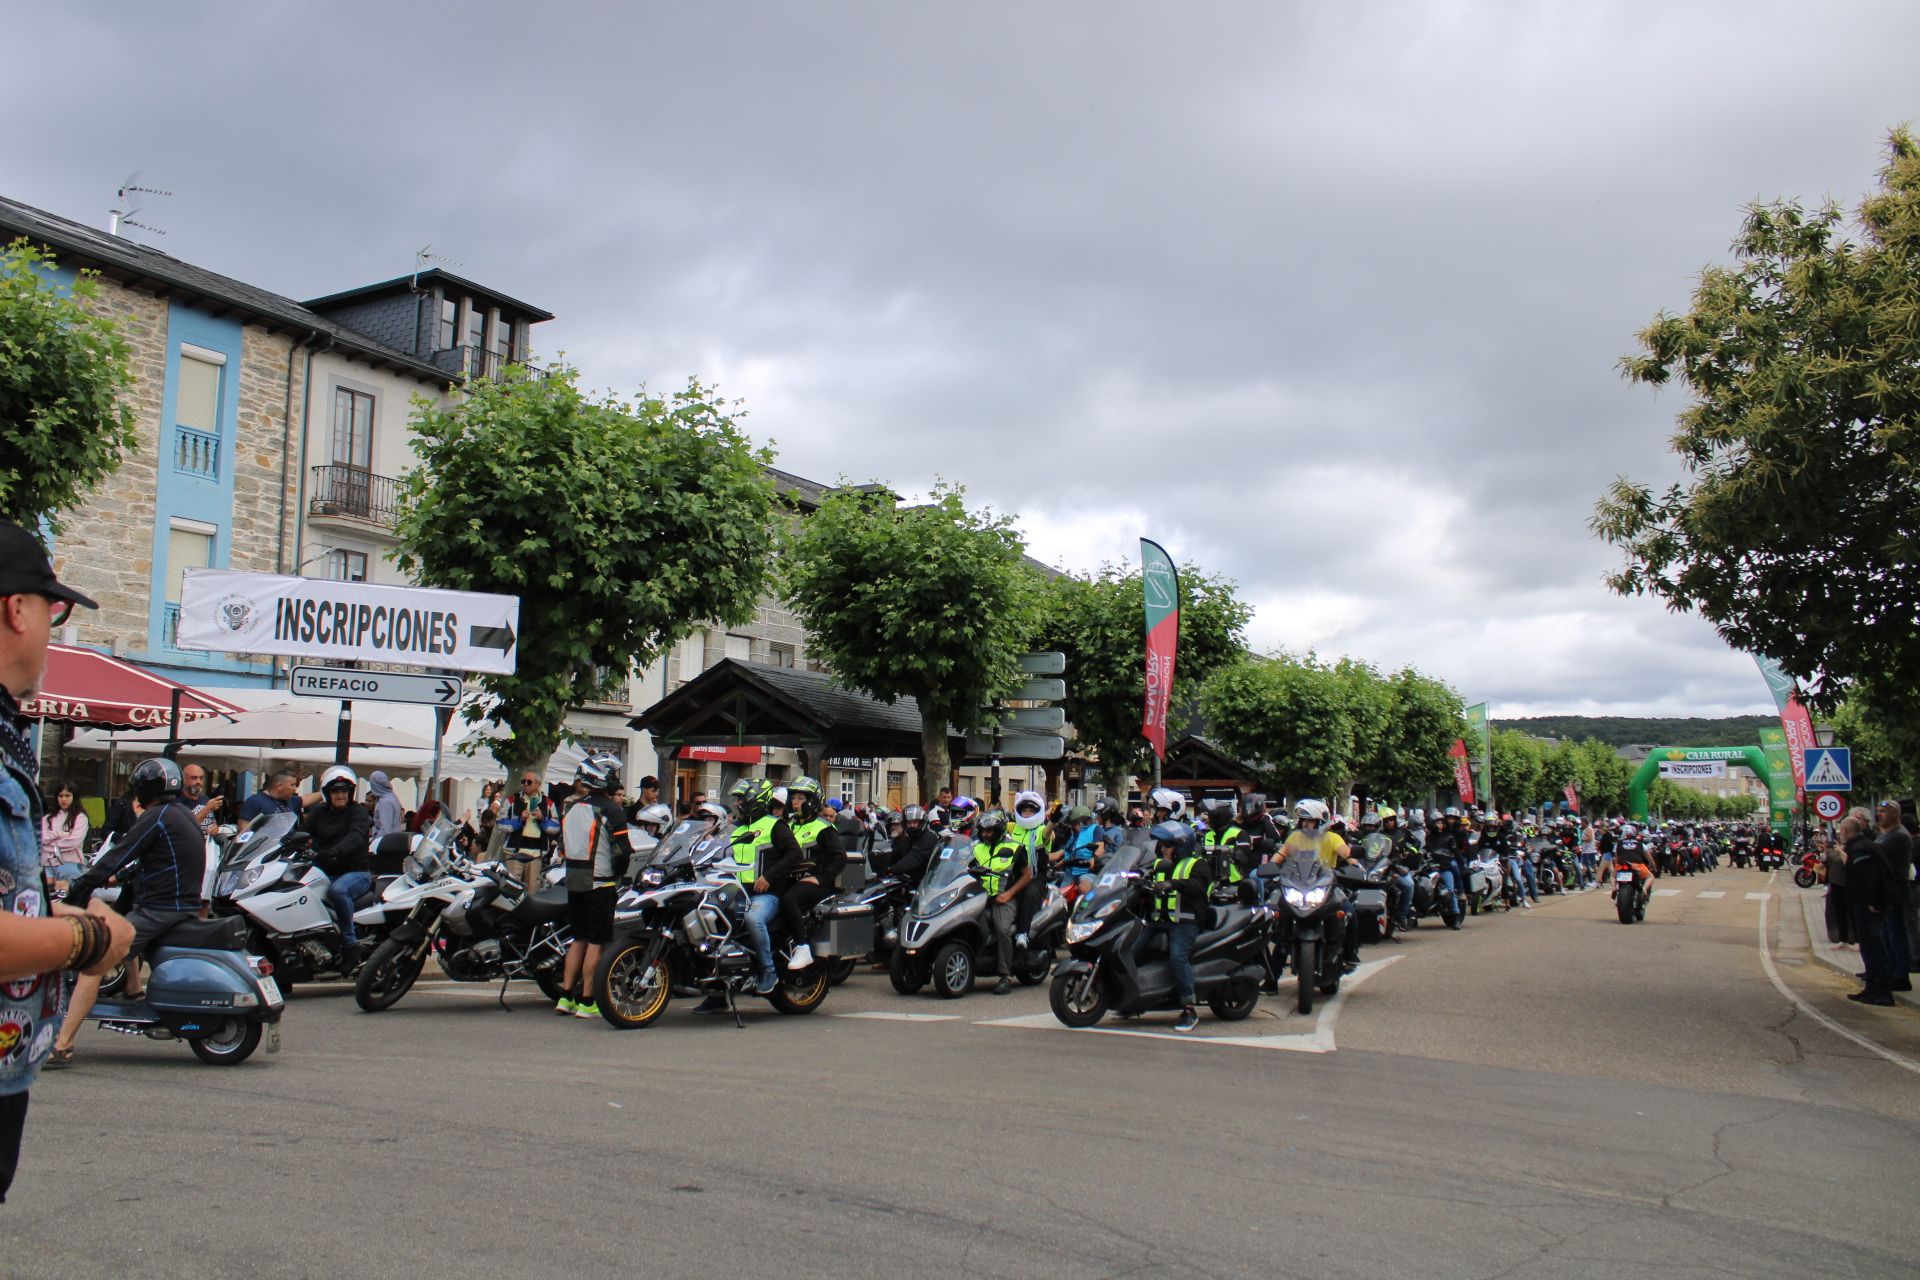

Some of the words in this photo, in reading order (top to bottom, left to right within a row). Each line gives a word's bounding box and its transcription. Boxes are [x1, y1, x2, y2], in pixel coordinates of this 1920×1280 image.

[274, 597, 458, 655] INSCRIPCIONES
[297, 675, 379, 693] TREFACIO
[1686, 751, 1710, 760] CAJA
[1711, 750, 1746, 759] RURAL
[1671, 764, 1713, 775] INSCRIPCIONES
[1819, 801, 1838, 811] 30
